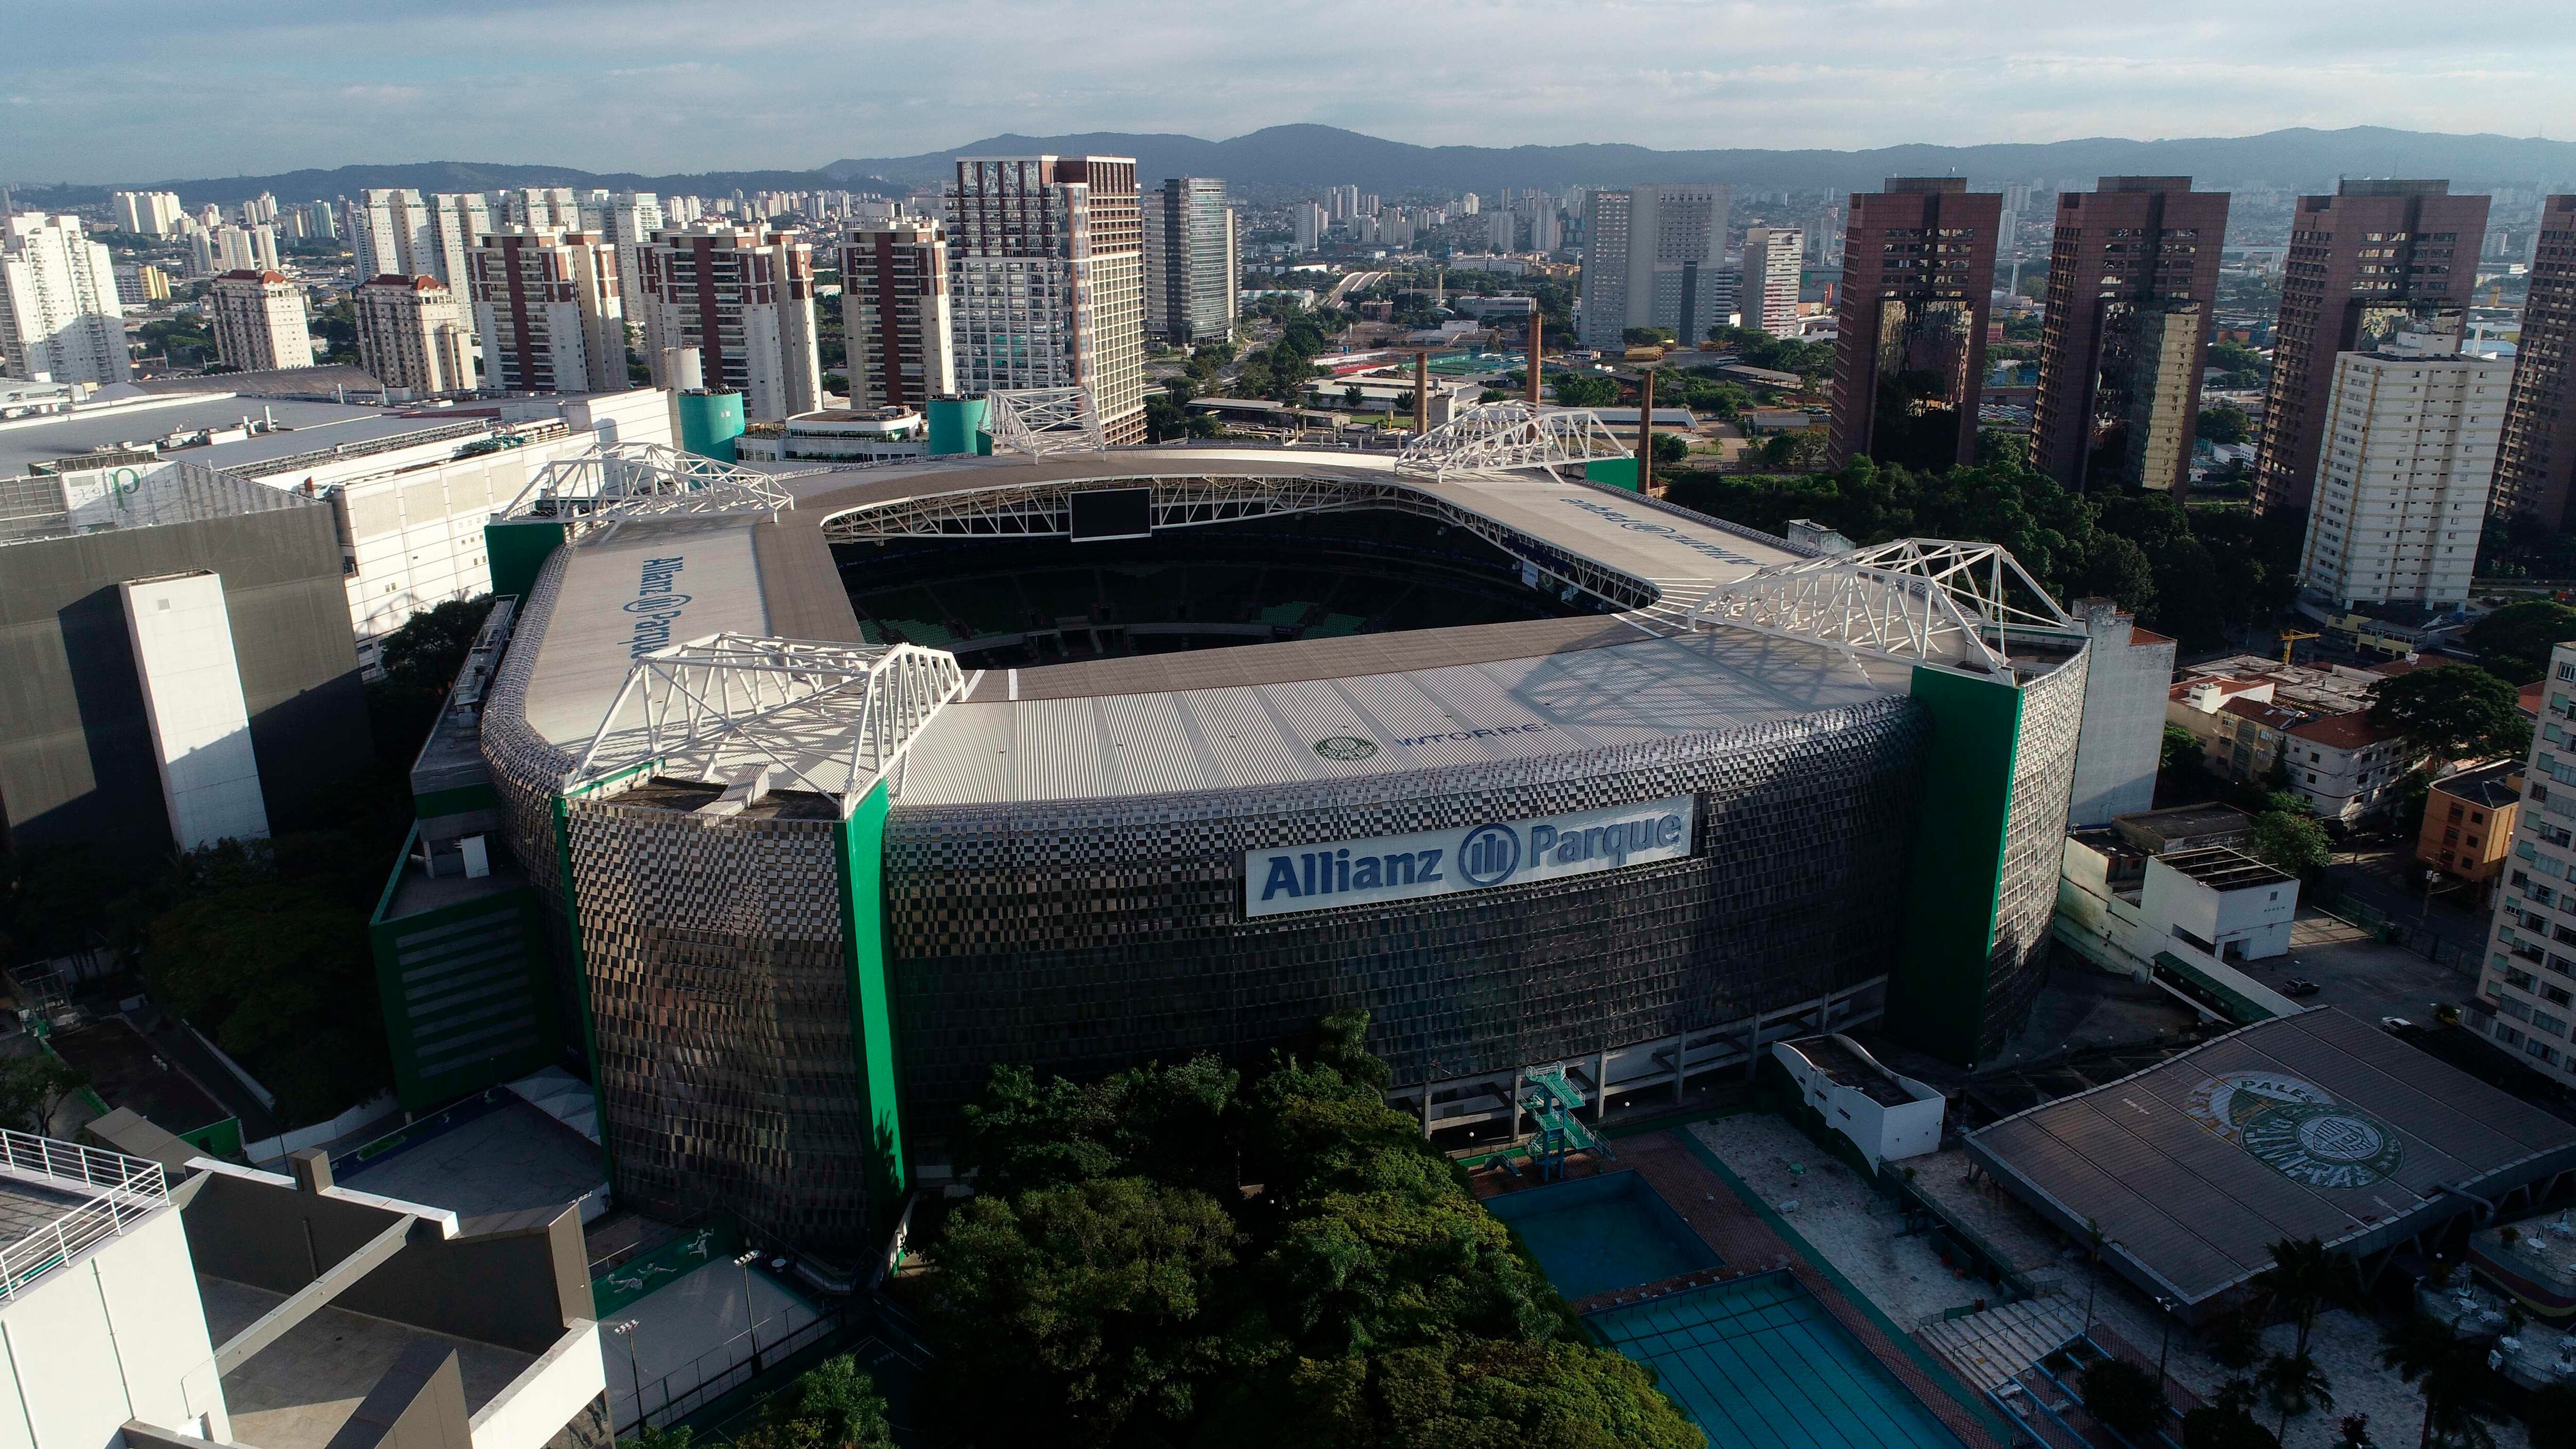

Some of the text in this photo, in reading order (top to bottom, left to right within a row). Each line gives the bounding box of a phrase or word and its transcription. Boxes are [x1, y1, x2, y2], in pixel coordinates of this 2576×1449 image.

[1559, 498, 1769, 566] Allianz Parque
[639, 556, 684, 596] Allianz
[1395, 723, 1544, 747] WTORRE
[1261, 813, 1682, 901] Allianz Parque
